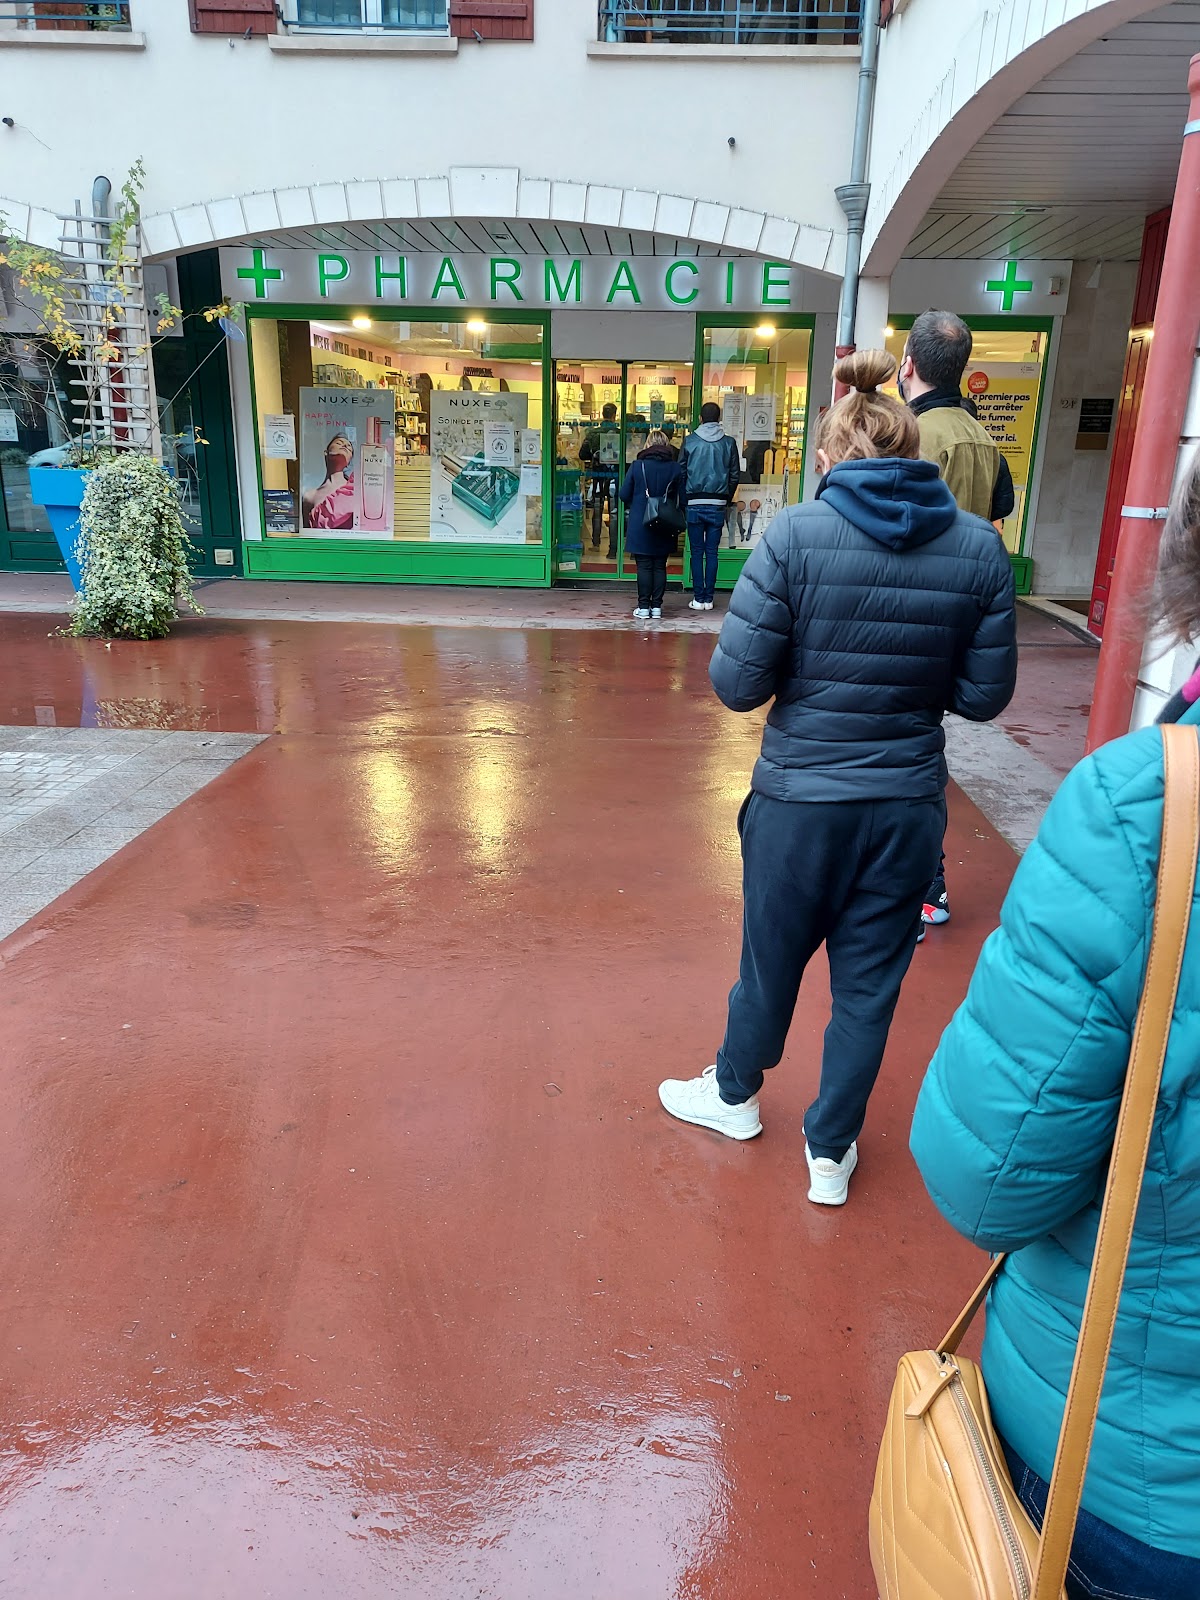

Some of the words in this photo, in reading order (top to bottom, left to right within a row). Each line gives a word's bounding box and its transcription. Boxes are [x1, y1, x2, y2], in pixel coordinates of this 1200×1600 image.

[318, 254, 792, 306] PHARMACIE
[318, 396, 359, 404] NUXE
[967, 392, 977, 400] Le
[979, 392, 1012, 402] premier
[1014, 394, 1030, 402] pas
[449, 399, 492, 407] NUXE
[992, 403, 1023, 411] arrêter
[988, 413, 1016, 422] fumer,
[1005, 434, 1017, 442] ici.
